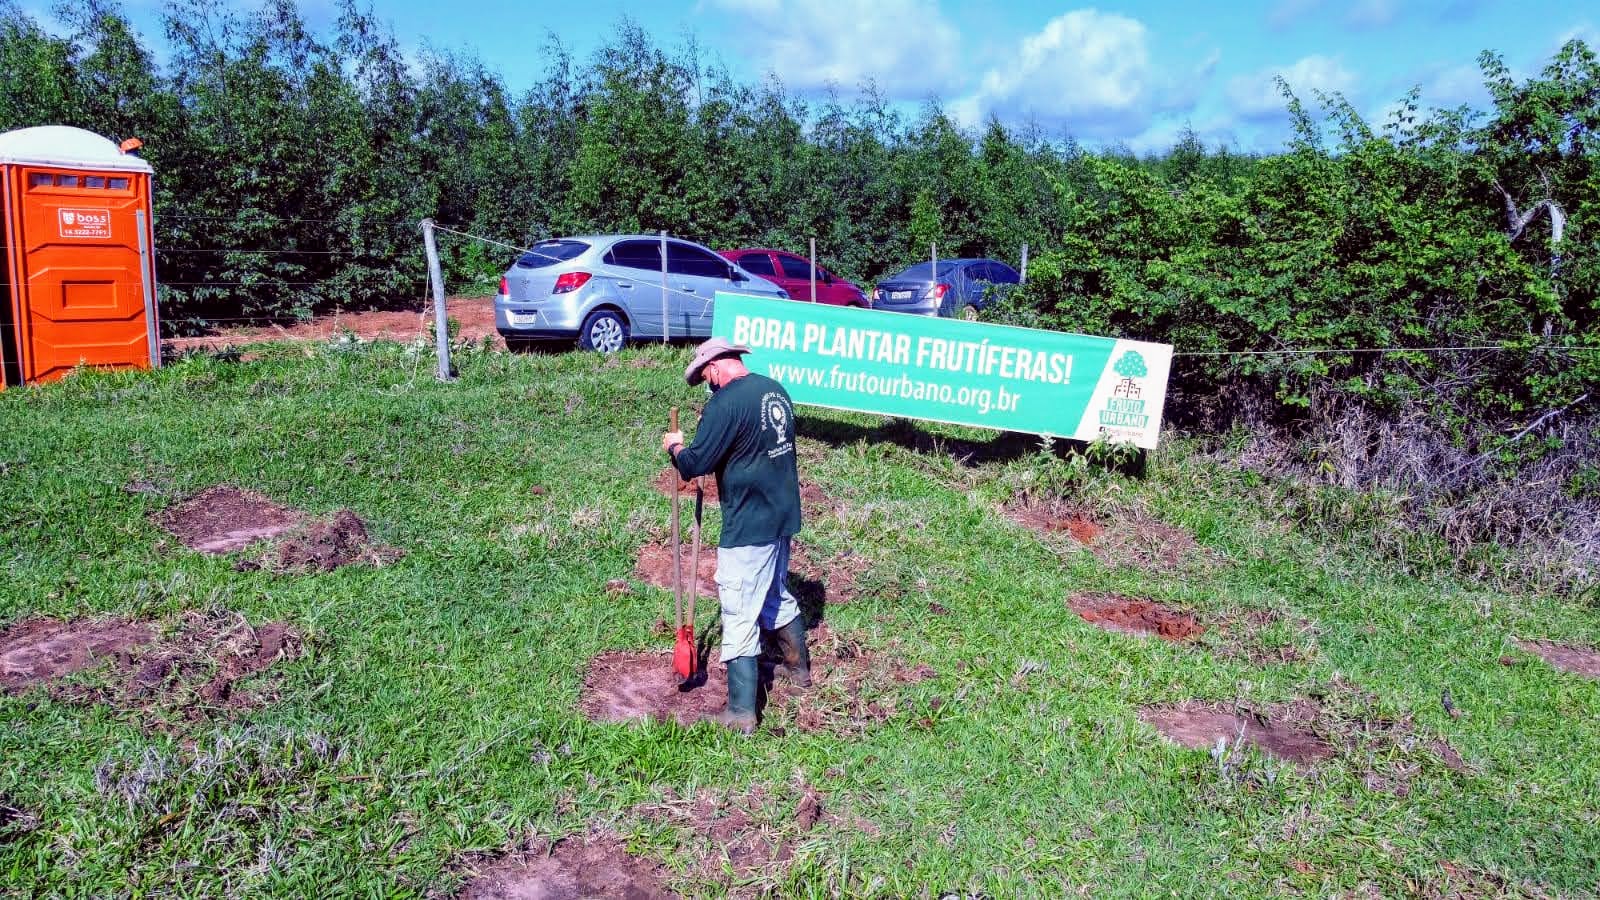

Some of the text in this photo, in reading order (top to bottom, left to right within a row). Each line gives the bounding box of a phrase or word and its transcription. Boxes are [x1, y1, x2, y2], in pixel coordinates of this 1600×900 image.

[733, 315, 1073, 385] BORA PLANTAR FRUTÍFERAS!
[768, 363, 1021, 414] www.frutourbano.org.br
[1102, 412, 1145, 427] URBANO
[1110, 399, 1142, 412] FRUTO
